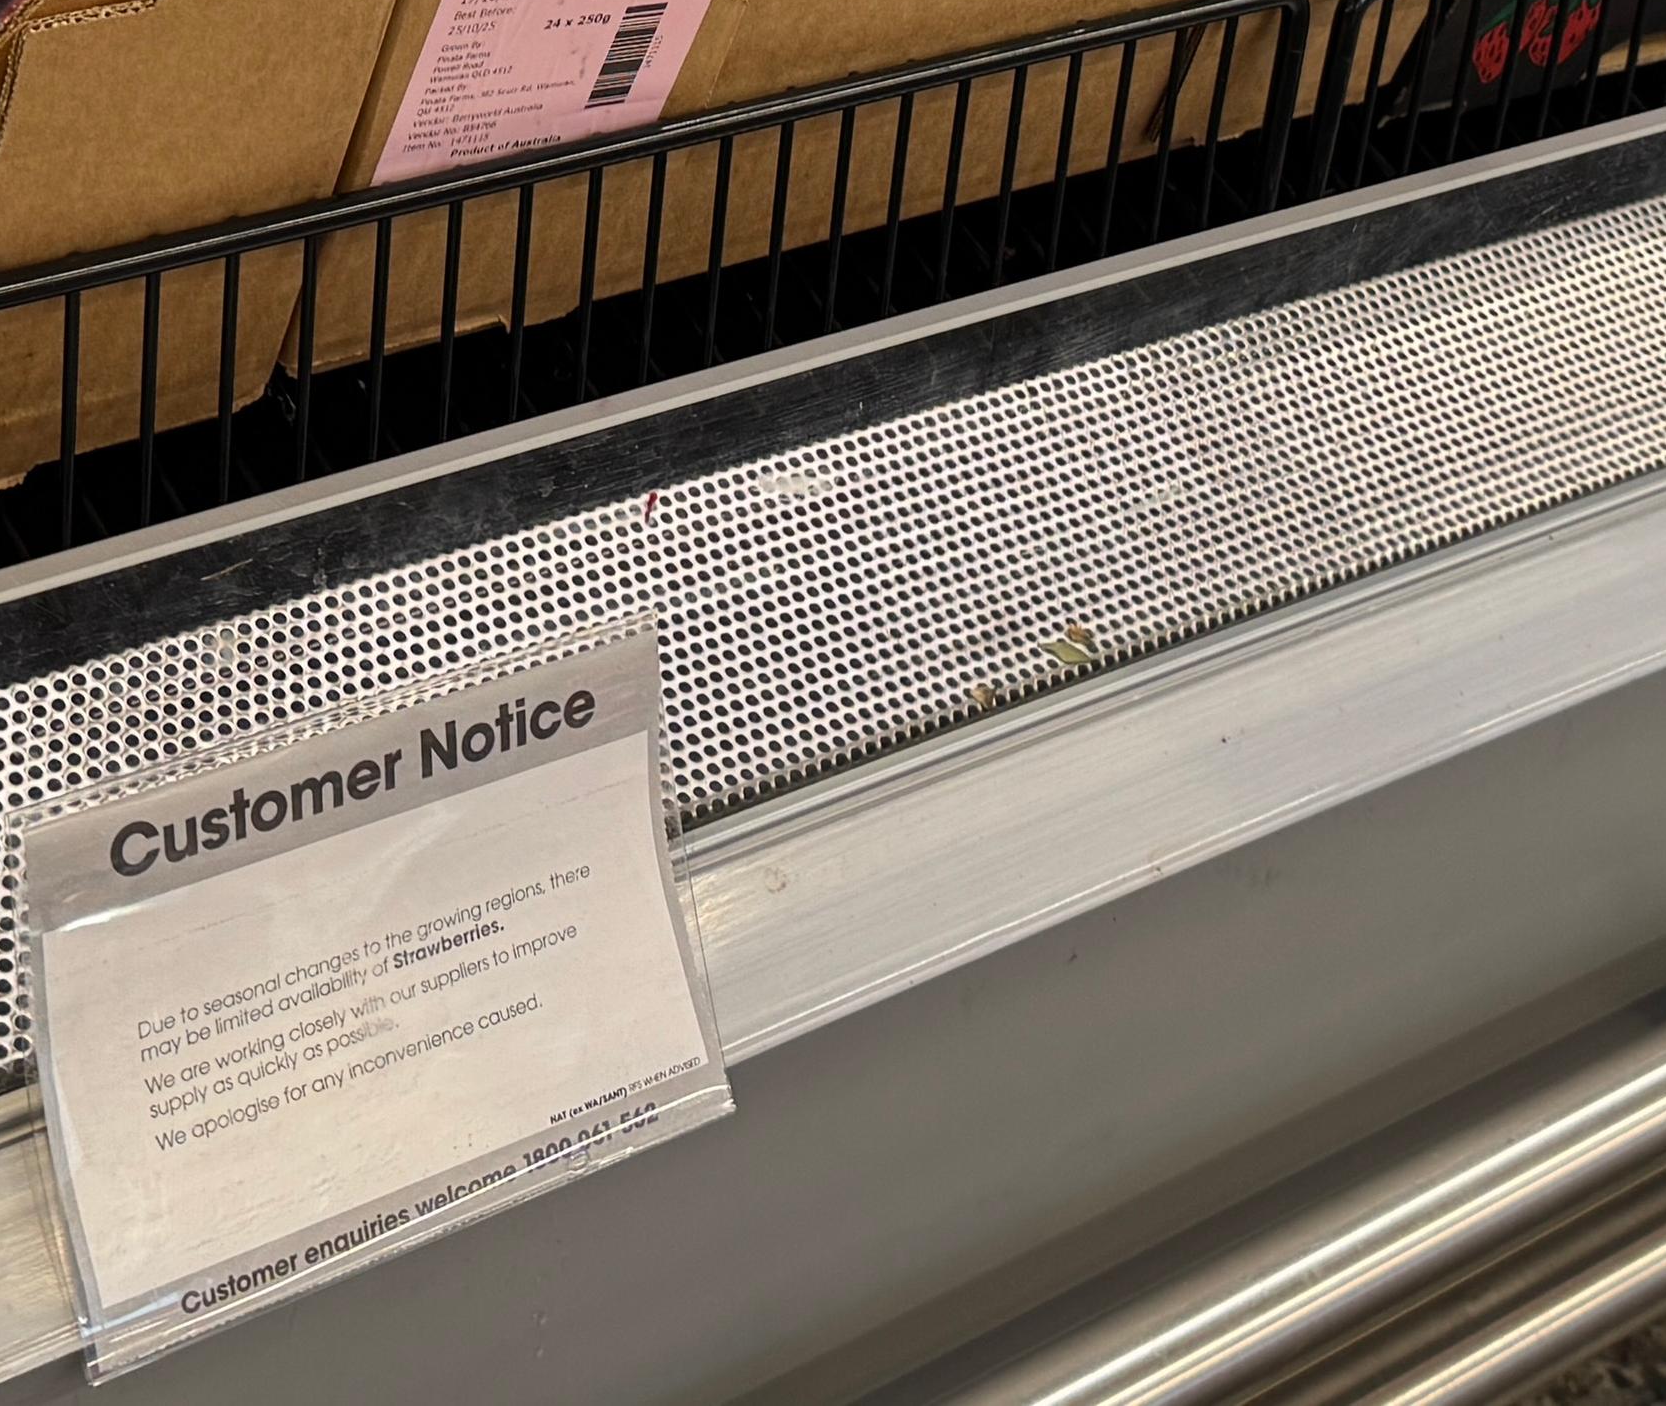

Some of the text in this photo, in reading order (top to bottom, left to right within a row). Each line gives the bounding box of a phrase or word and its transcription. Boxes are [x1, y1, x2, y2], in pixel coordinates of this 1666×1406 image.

[448, 21, 496, 36] 25/10/25
[454, 10, 477, 22] Best
[544, 18, 561, 30] 24
[577, 12, 612, 27] 250g
[450, 134, 562, 158] Product of Australia
[109, 689, 596, 877] Customer Notice
[137, 865, 590, 1040] Due to seasonal changes to the growing regions, there
[140, 920, 505, 1063] may be limited availability of Strawberries.
[143, 1073, 176, 1095] We
[180, 1060, 211, 1082] are
[214, 1033, 286, 1070] working
[288, 1009, 346, 1043] closely
[389, 983, 416, 1005] our
[420, 957, 490, 994] suppliers
[492, 949, 510, 967] to
[511, 925, 577, 960] improve
[149, 1085, 208, 1119] supply
[212, 1076, 234, 1095] as
[237, 1051, 298, 1087] quickly
[302, 1043, 324, 1062] as
[155, 993, 543, 1151] We apologise for any inconvenience caused.
[550, 1111, 568, 1125] NAT
[180, 1254, 300, 1315] Customer
[304, 1205, 411, 1266] enquiries
[415, 1161, 518, 1221] welcome
